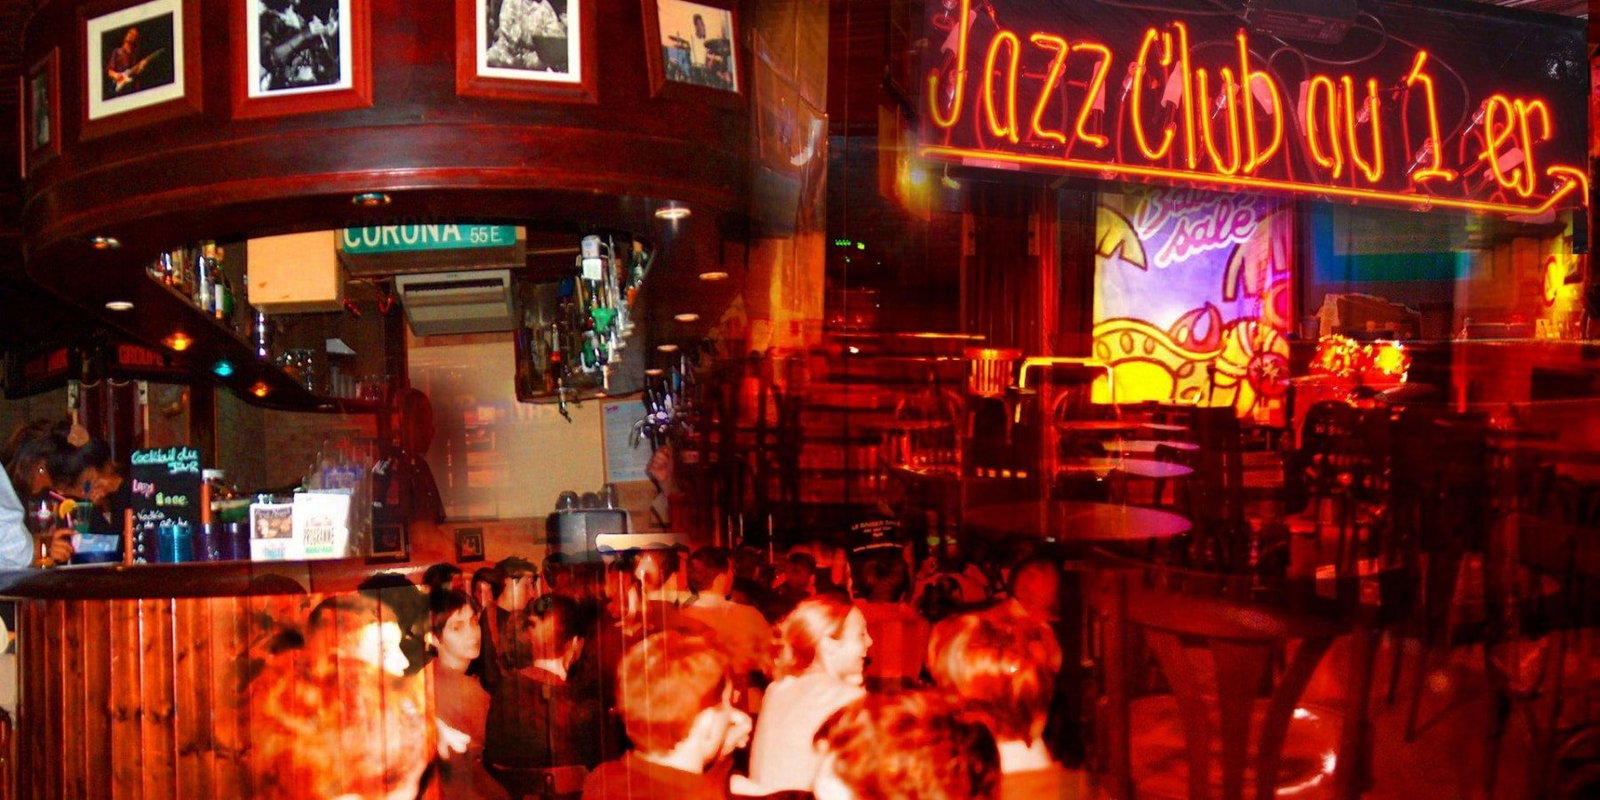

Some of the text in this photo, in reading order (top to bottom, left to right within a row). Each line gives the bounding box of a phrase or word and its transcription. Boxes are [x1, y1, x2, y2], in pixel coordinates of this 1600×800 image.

[929, 0, 1109, 149] Jazz
[1132, 20, 1283, 175] Club
[1305, 73, 1385, 183] au
[343, 223, 462, 248] CORONA
[470, 226, 488, 244] 55
[1154, 191, 1257, 269] salé
[177, 446, 199, 461] du
